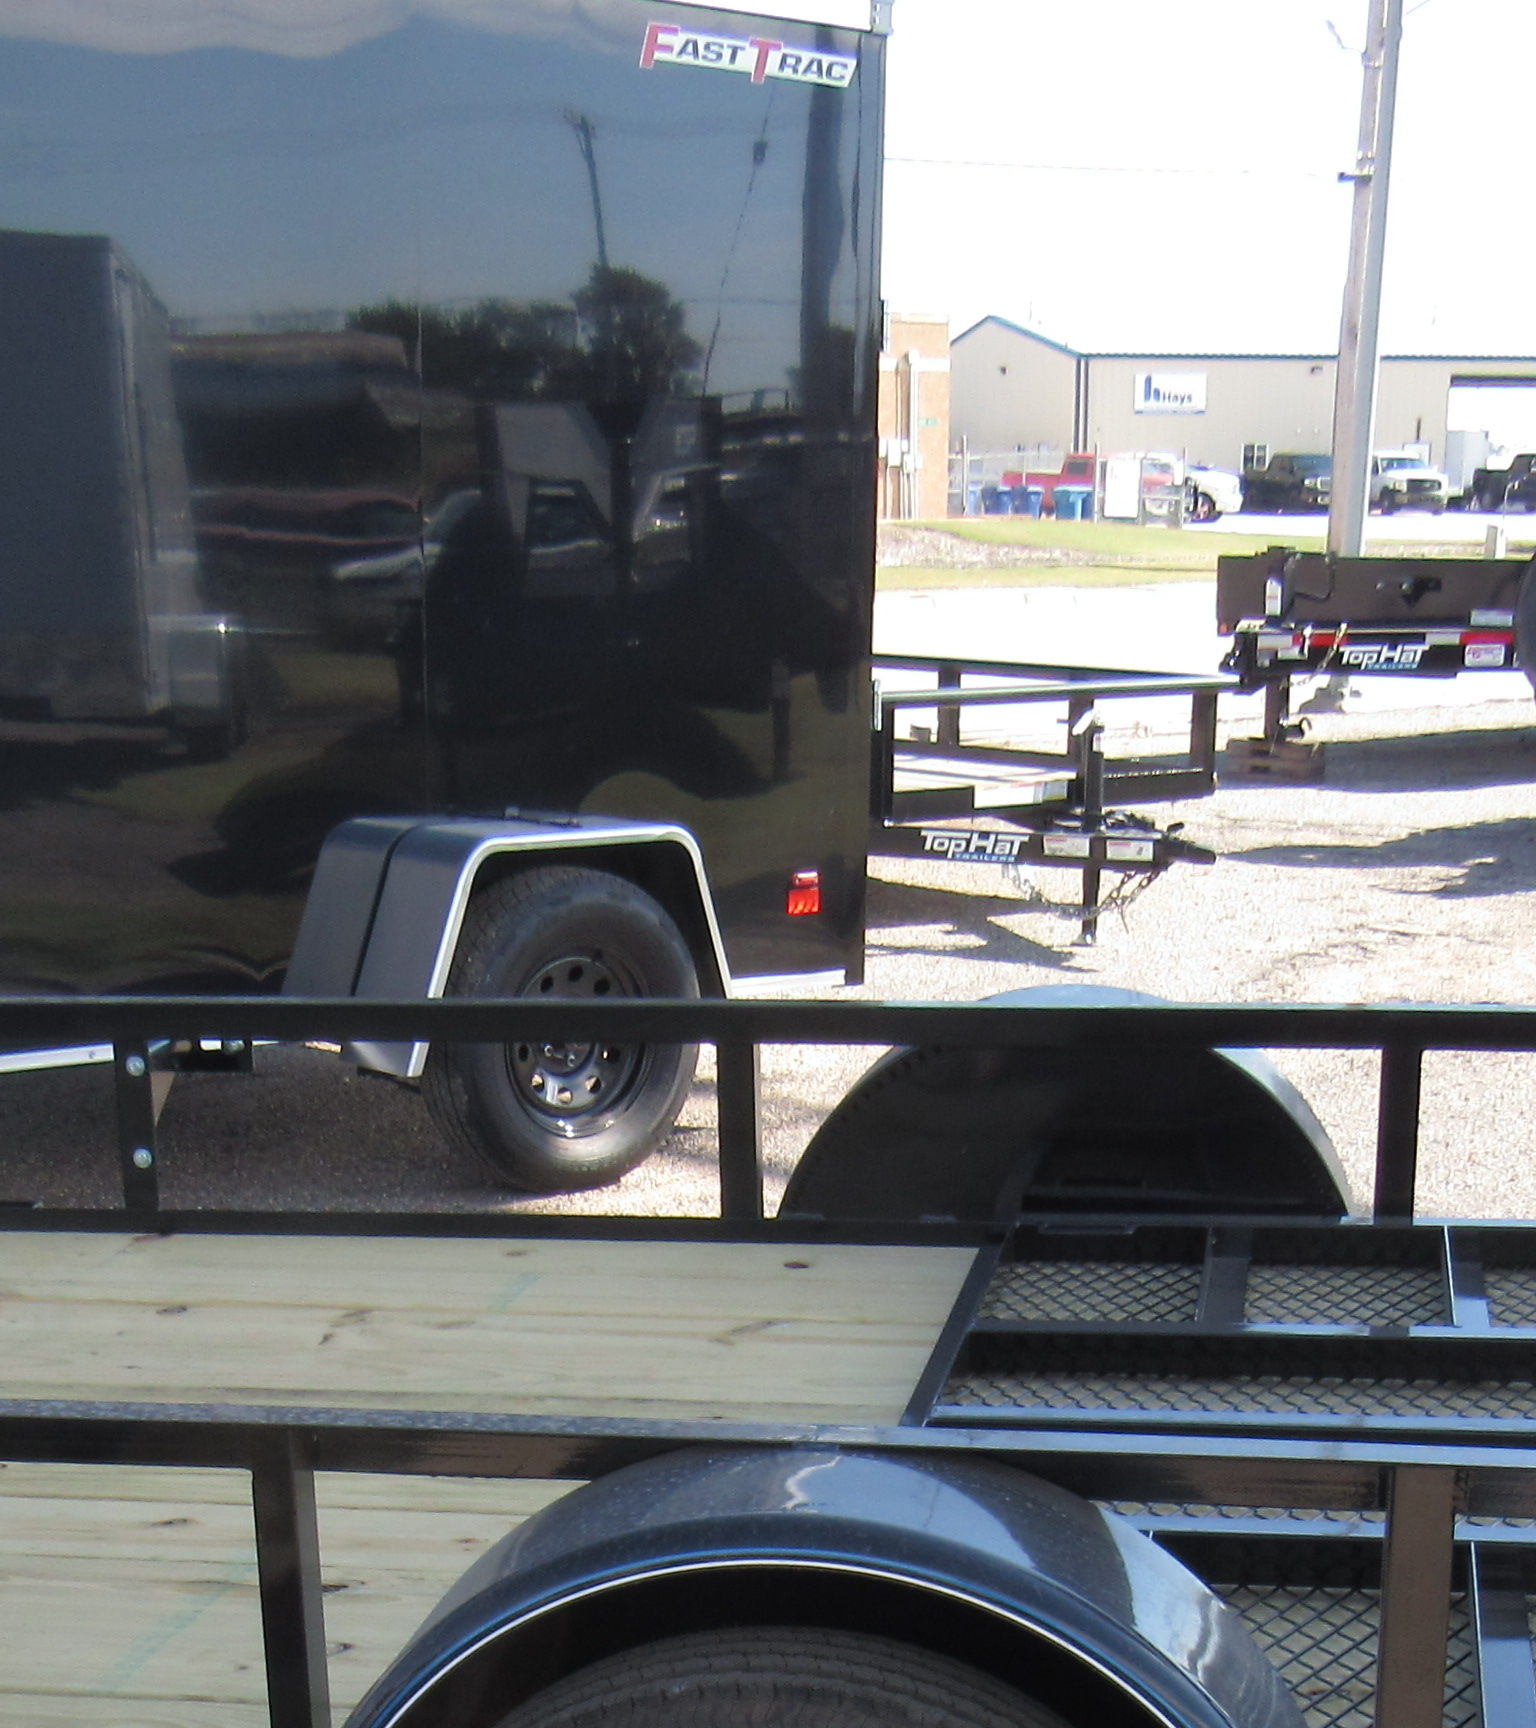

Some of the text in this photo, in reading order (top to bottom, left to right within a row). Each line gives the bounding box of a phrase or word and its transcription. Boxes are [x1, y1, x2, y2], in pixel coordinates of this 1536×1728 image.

[640, 23, 848, 84] FAST TRAC
[1163, 391, 1192, 406] Hays
